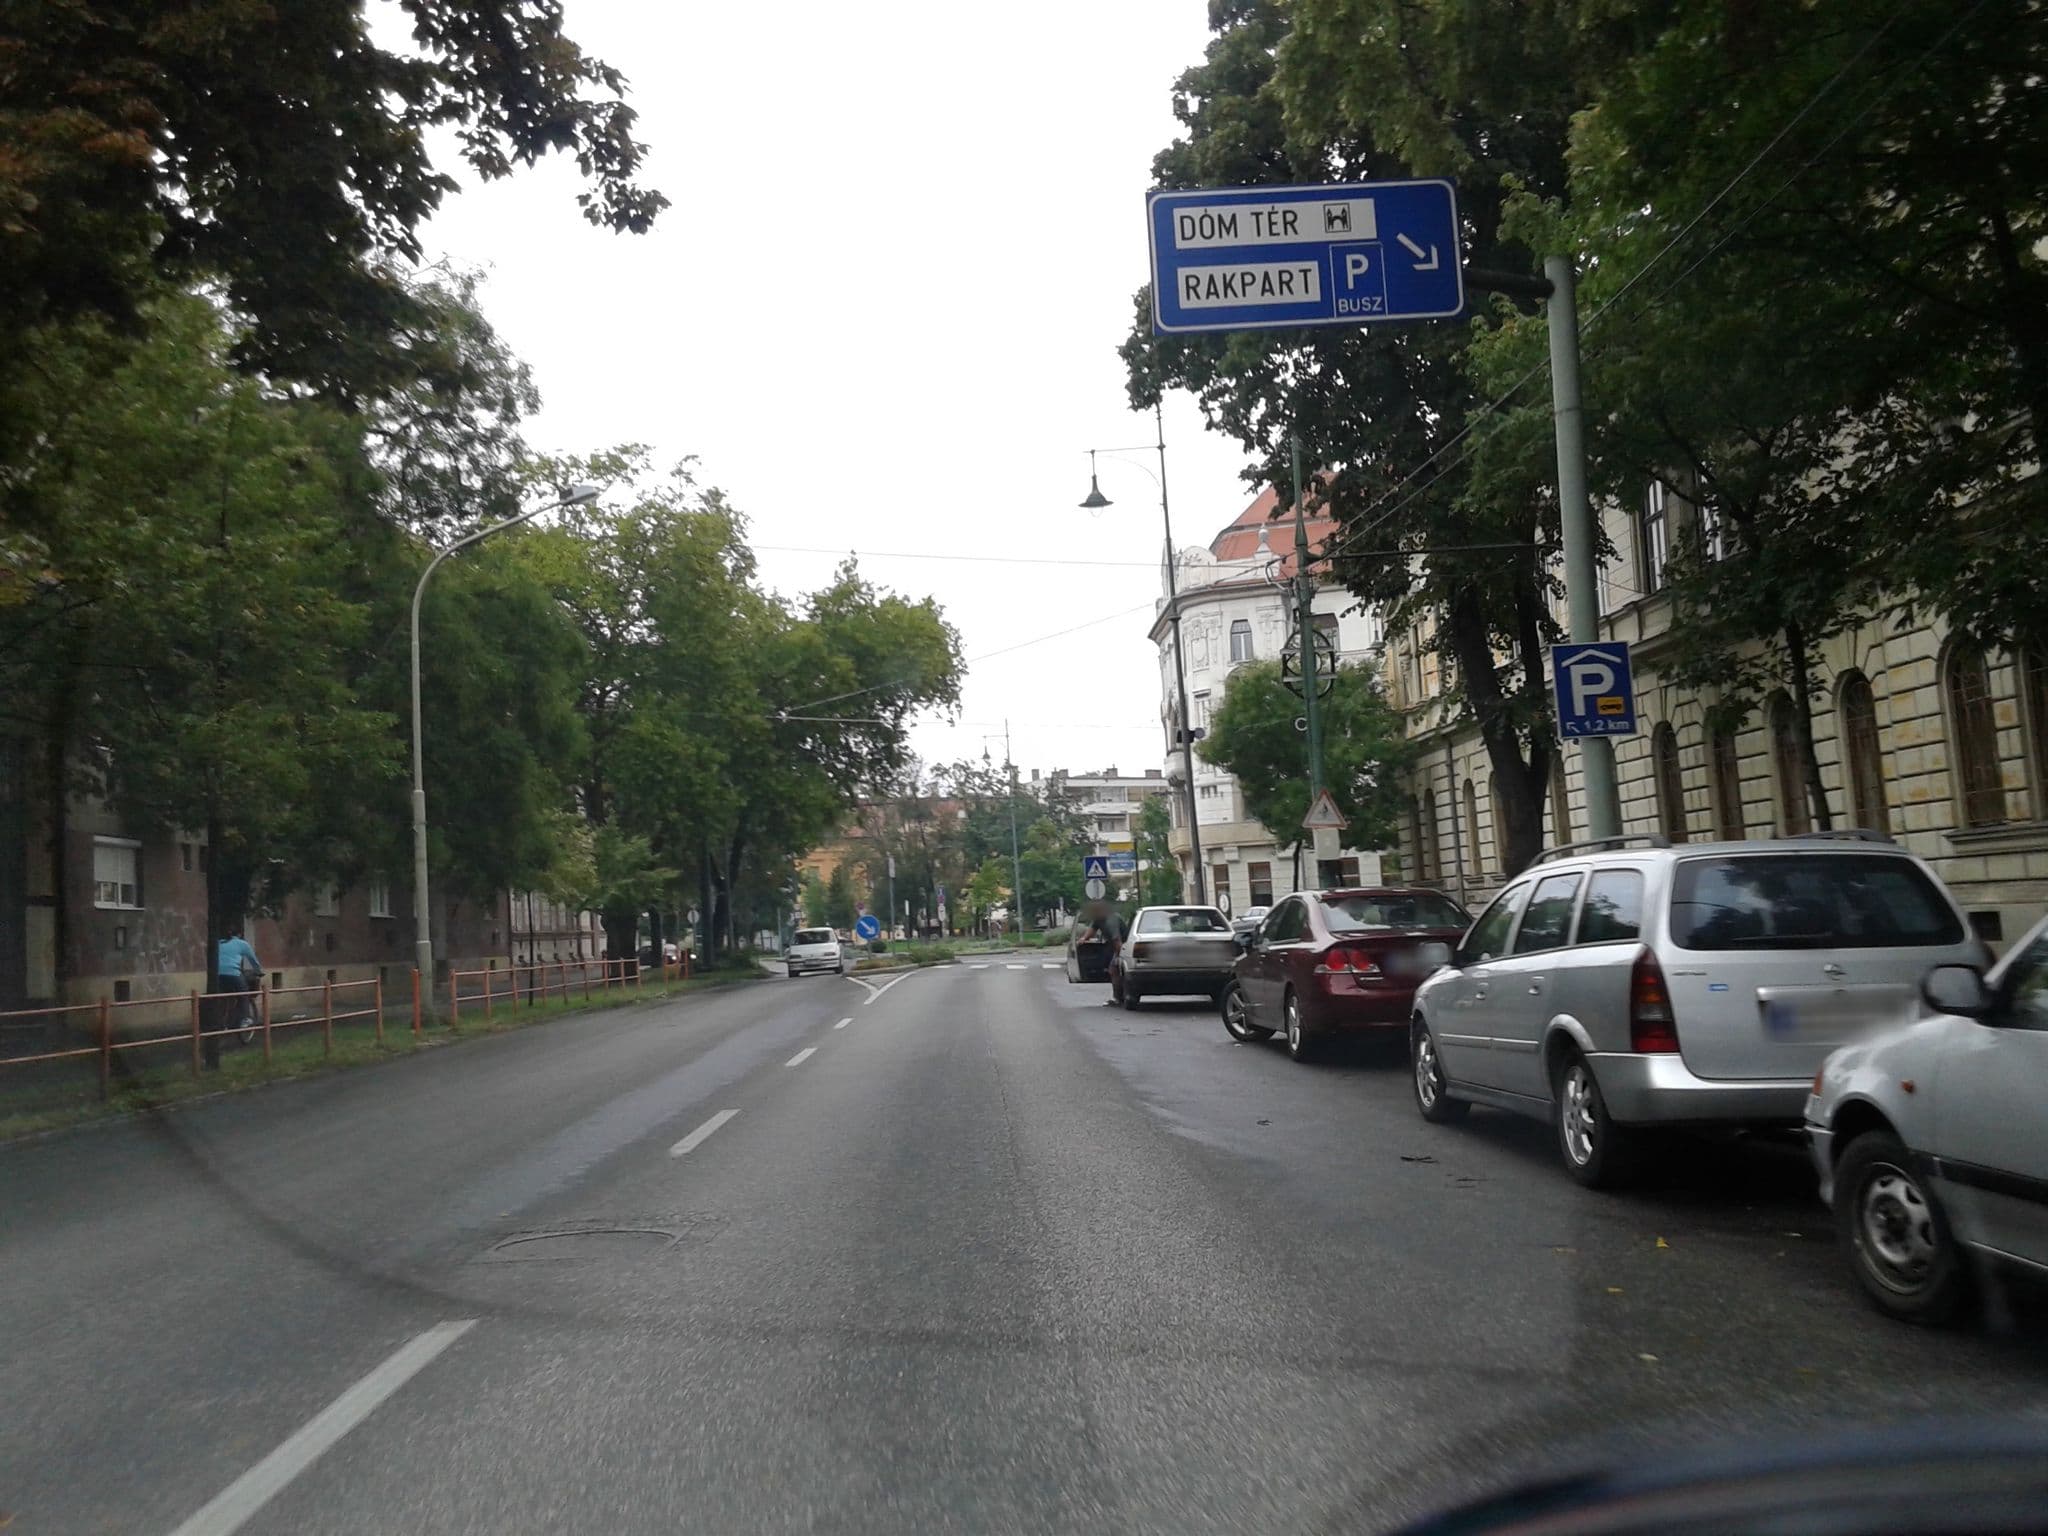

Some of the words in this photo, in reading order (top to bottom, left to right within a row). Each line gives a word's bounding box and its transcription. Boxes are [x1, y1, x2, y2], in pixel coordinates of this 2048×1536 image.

[1180, 208, 1238, 242] DÓM
[1250, 205, 1299, 237] TÉR
[1184, 268, 1312, 302] RAKPART
[1346, 253, 1369, 290] P
[1338, 296, 1384, 314] BUSZ
[1570, 663, 1615, 716] P
[1607, 719, 1630, 730] km
